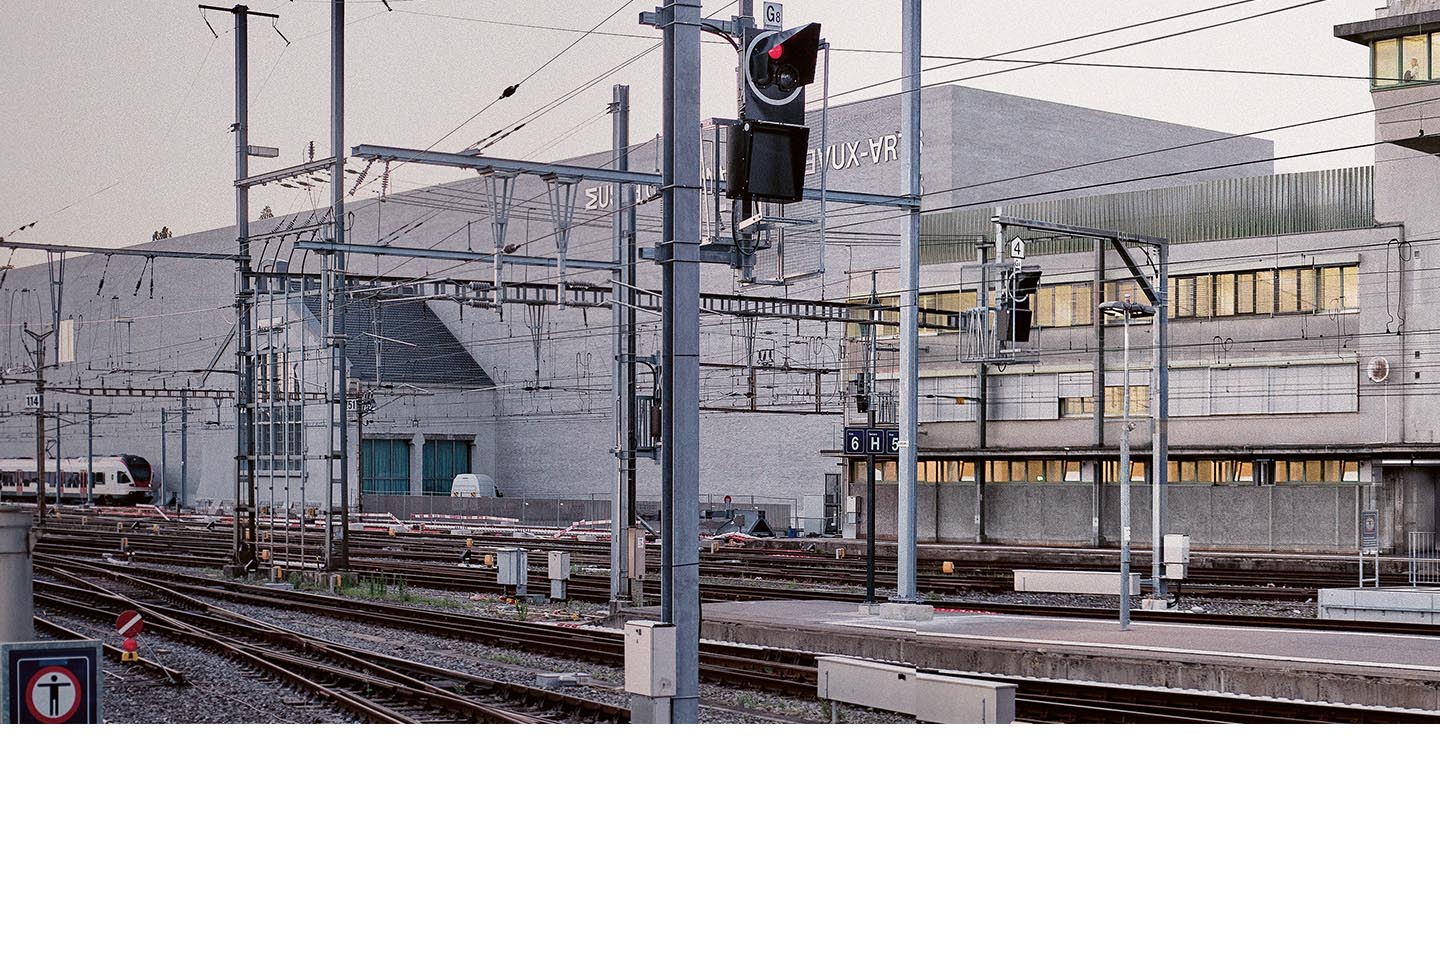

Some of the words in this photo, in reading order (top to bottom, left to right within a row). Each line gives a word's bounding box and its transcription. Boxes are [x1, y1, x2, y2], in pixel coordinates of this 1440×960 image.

[766, 5, 781, 23] G8
[1014, 241, 1021, 255] 4
[26, 396, 39, 406] 114
[851, 436, 859, 451] 6
[870, 436, 880, 451] H
[891, 437, 899, 451] 5
